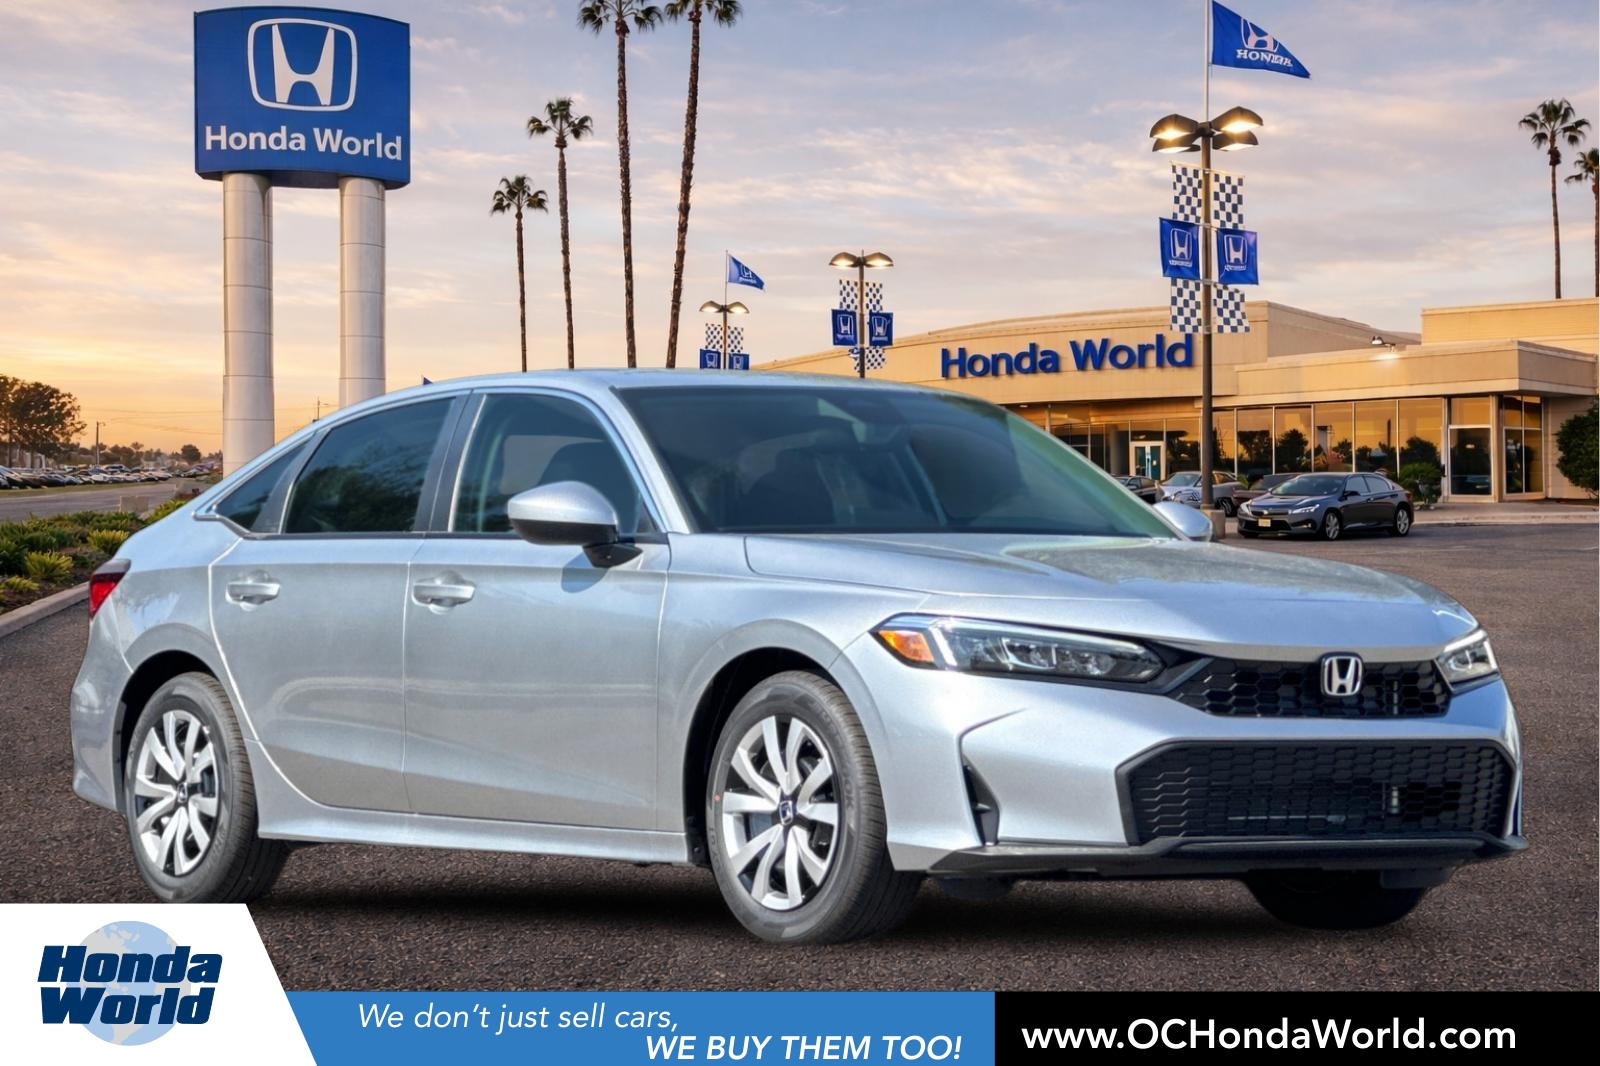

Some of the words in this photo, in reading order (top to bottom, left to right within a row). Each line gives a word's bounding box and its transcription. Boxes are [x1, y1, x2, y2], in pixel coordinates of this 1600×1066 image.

[205, 125, 306, 151] Honda
[313, 127, 402, 161] World
[941, 342, 1061, 378] Honda
[1070, 333, 1194, 371] World
